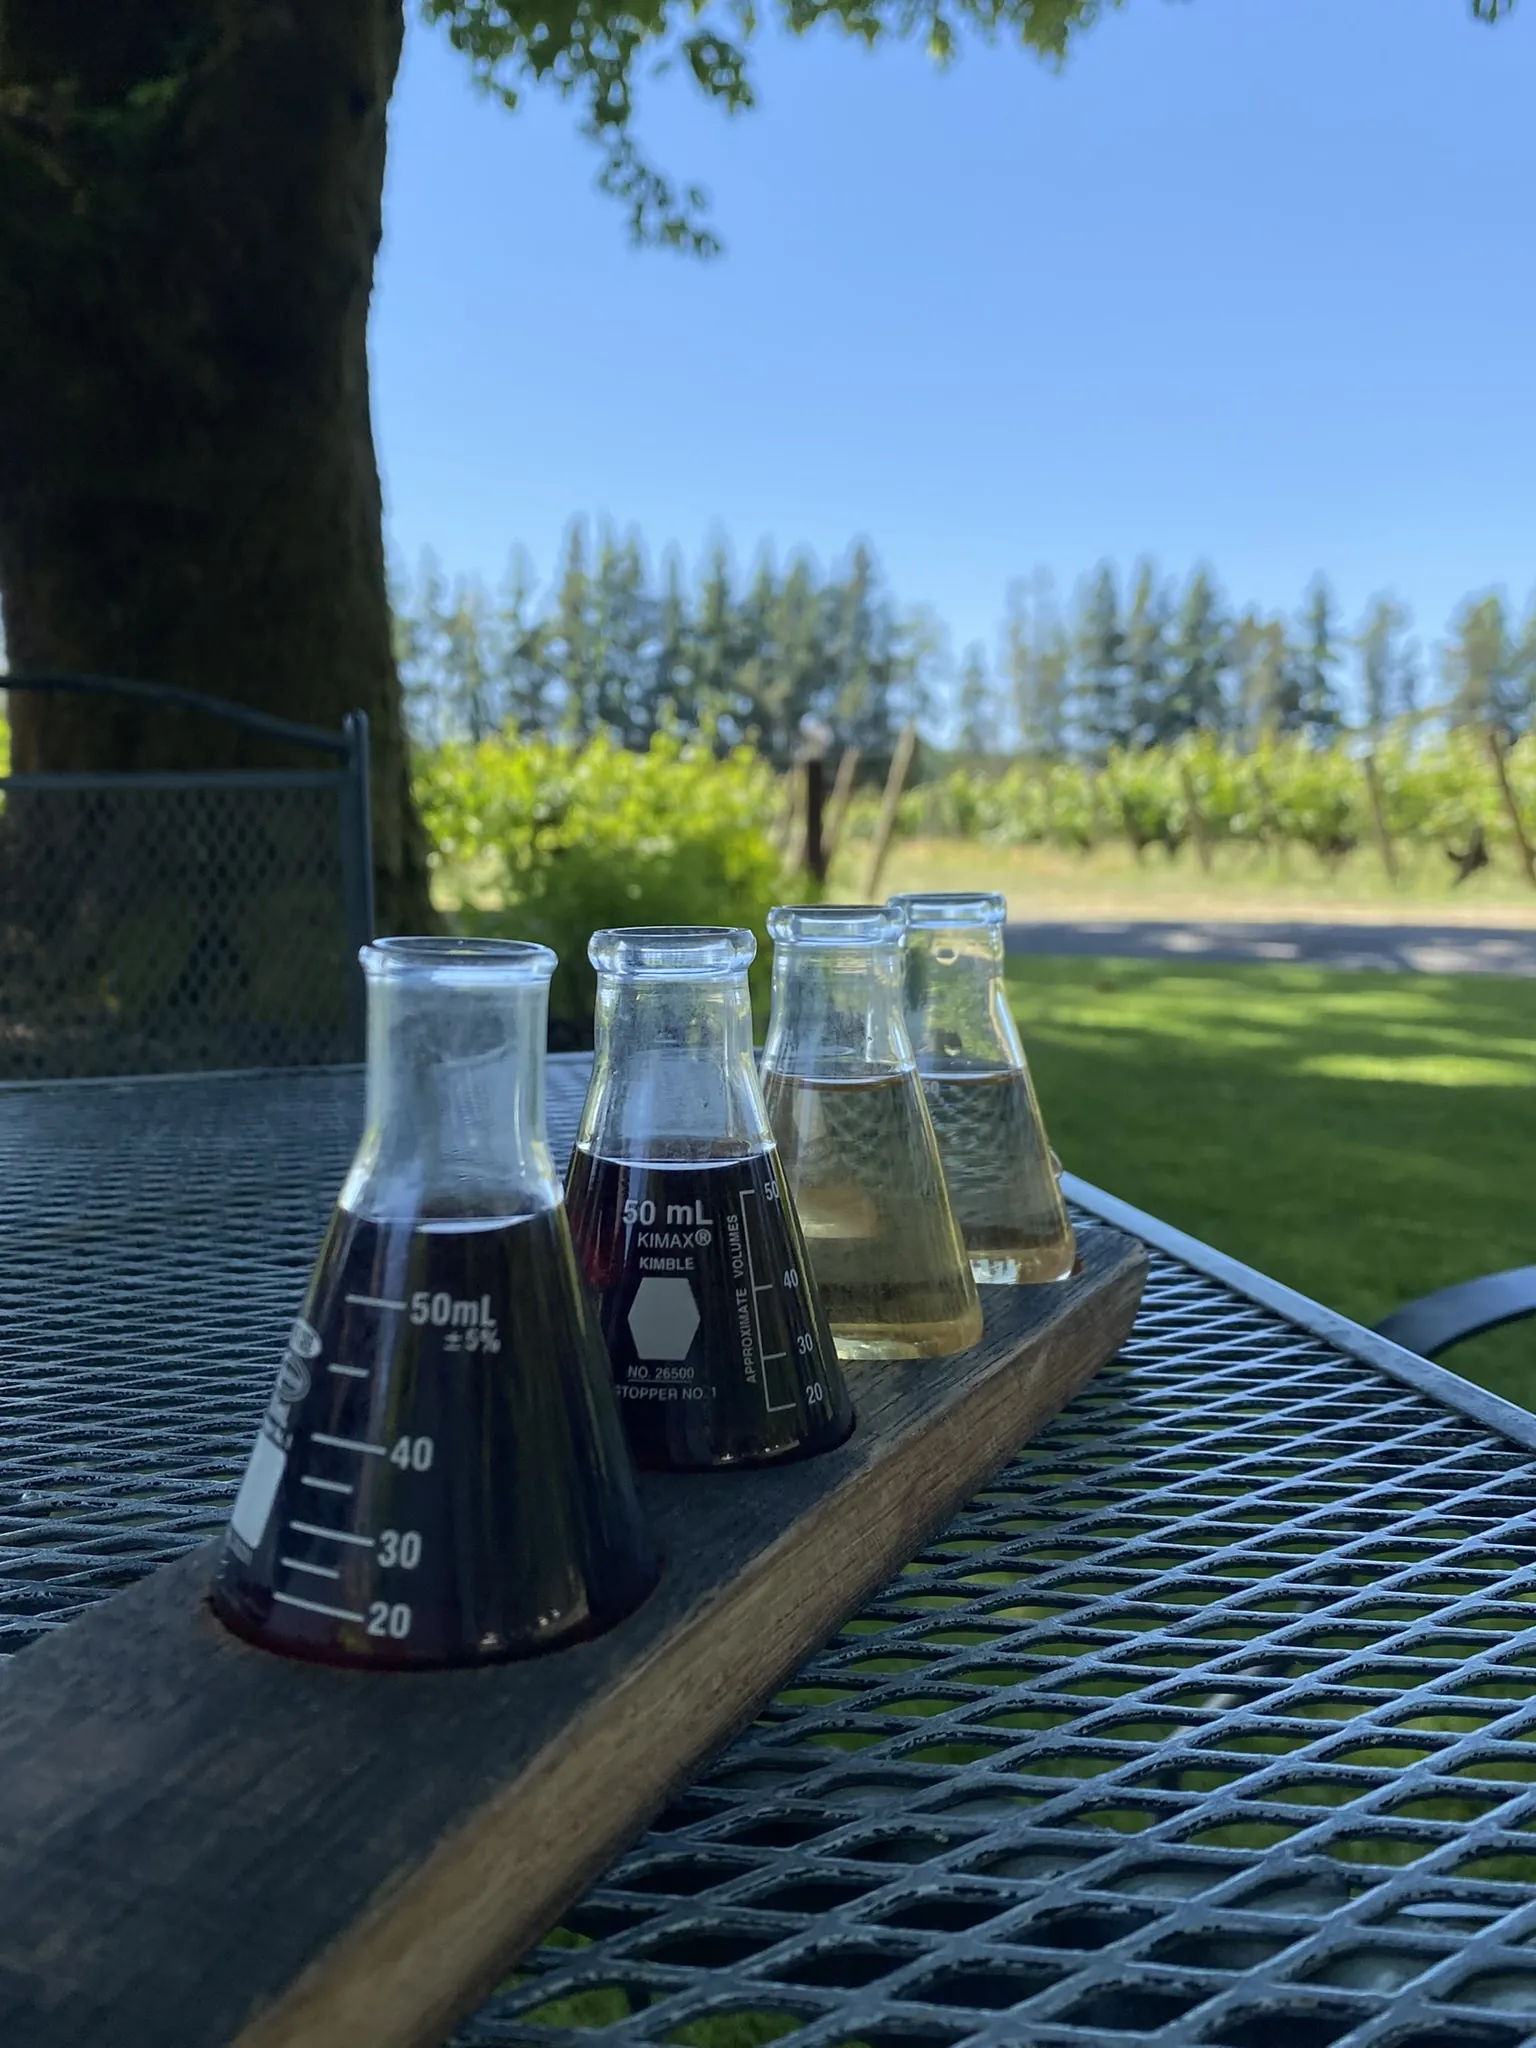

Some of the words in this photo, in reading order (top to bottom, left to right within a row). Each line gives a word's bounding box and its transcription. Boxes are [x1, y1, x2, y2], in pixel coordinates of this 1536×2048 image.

[764, 1180, 779, 1201] 50
[622, 1199, 656, 1226] 50
[667, 1199, 713, 1225] mL
[726, 1214, 744, 1279] VOLUMES
[639, 1256, 695, 1270] KIMBLE
[783, 1269, 799, 1289] 40
[408, 1291, 497, 1327] 50mL
[736, 1287, 757, 1384] APPROXIMATE
[797, 1334, 813, 1355] 30
[655, 1367, 695, 1380] 26500
[806, 1382, 823, 1405] 20
[390, 1436, 434, 1472] 40
[376, 1530, 422, 1570] 30
[367, 1601, 411, 1640] 20
